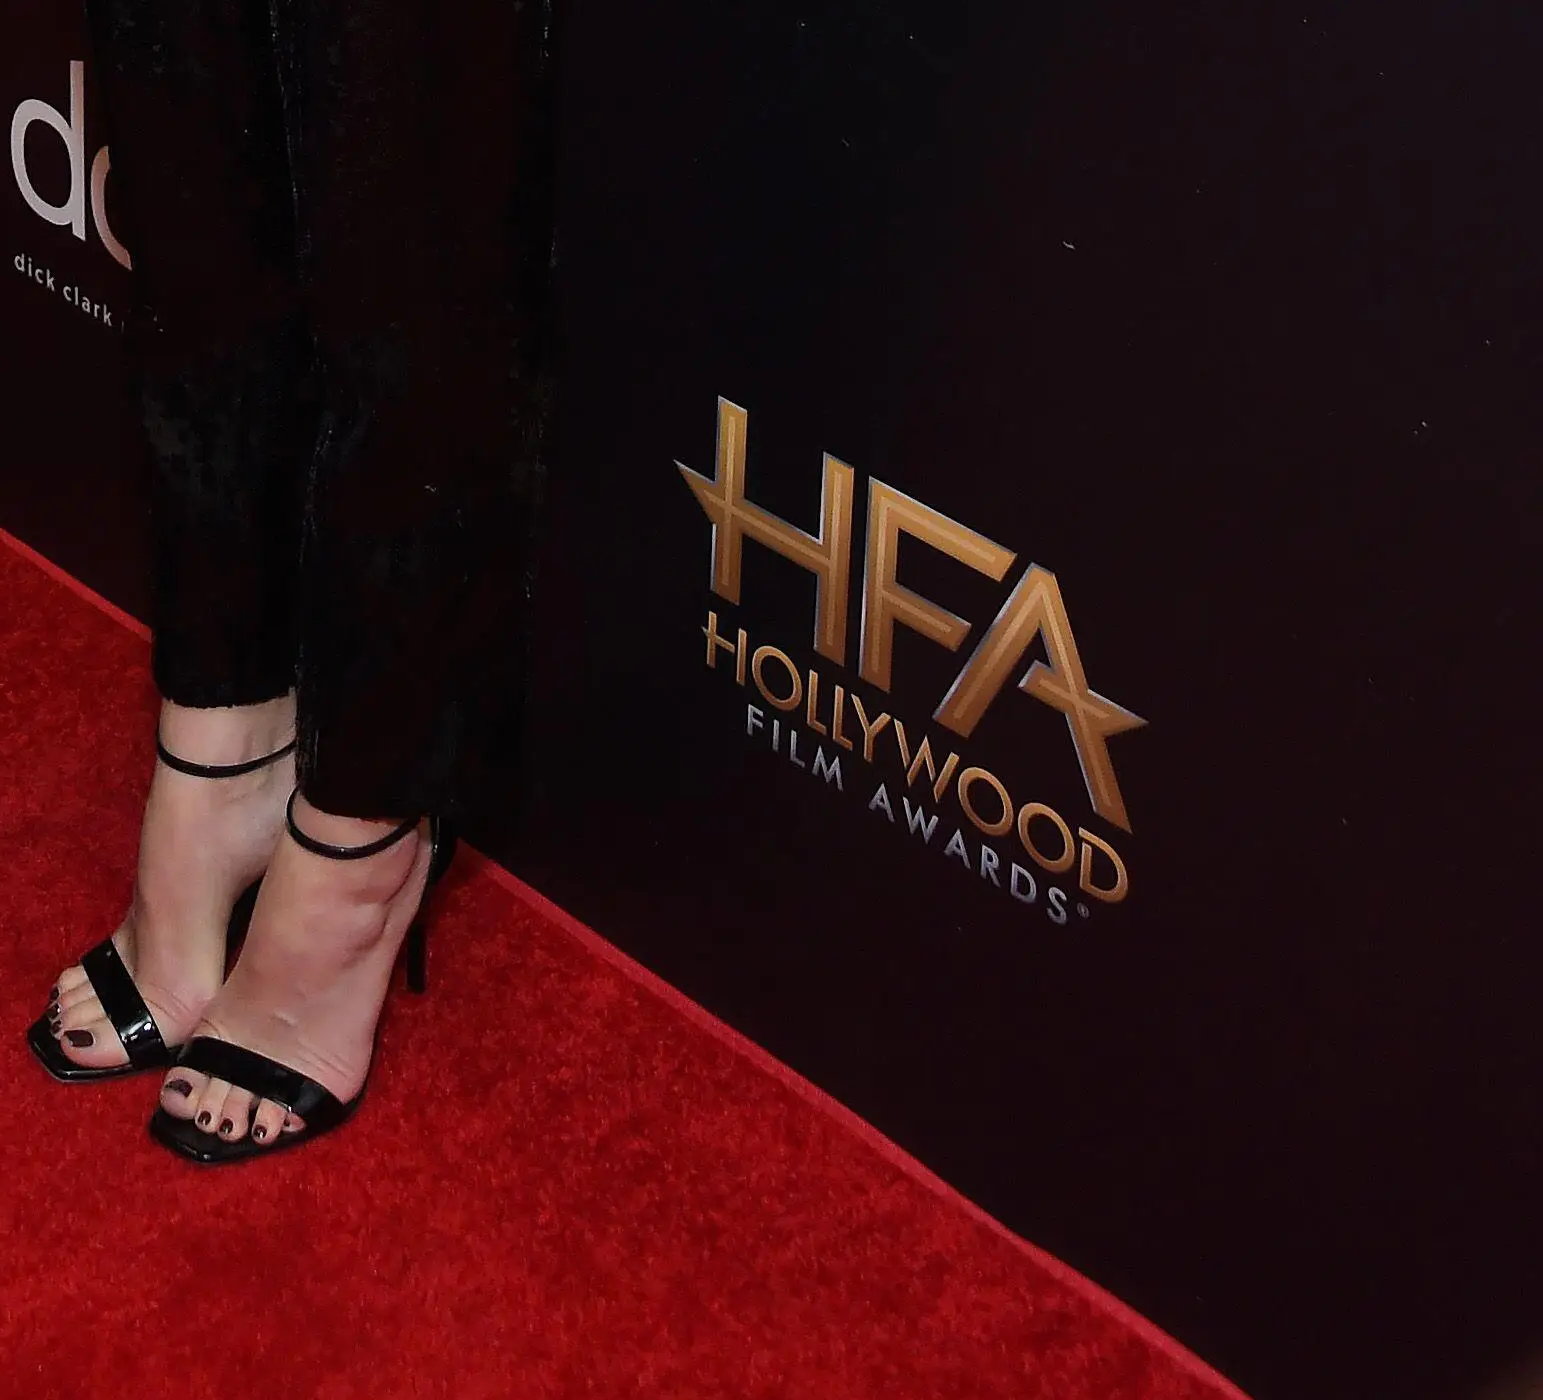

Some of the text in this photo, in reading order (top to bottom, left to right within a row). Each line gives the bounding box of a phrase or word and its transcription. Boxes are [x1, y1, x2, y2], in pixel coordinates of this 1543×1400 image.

[13, 252, 113, 327] dick clark
[673, 395, 1149, 835] HFA
[701, 611, 1128, 904] HOLLYWOOD
[746, 703, 845, 793] FILM
